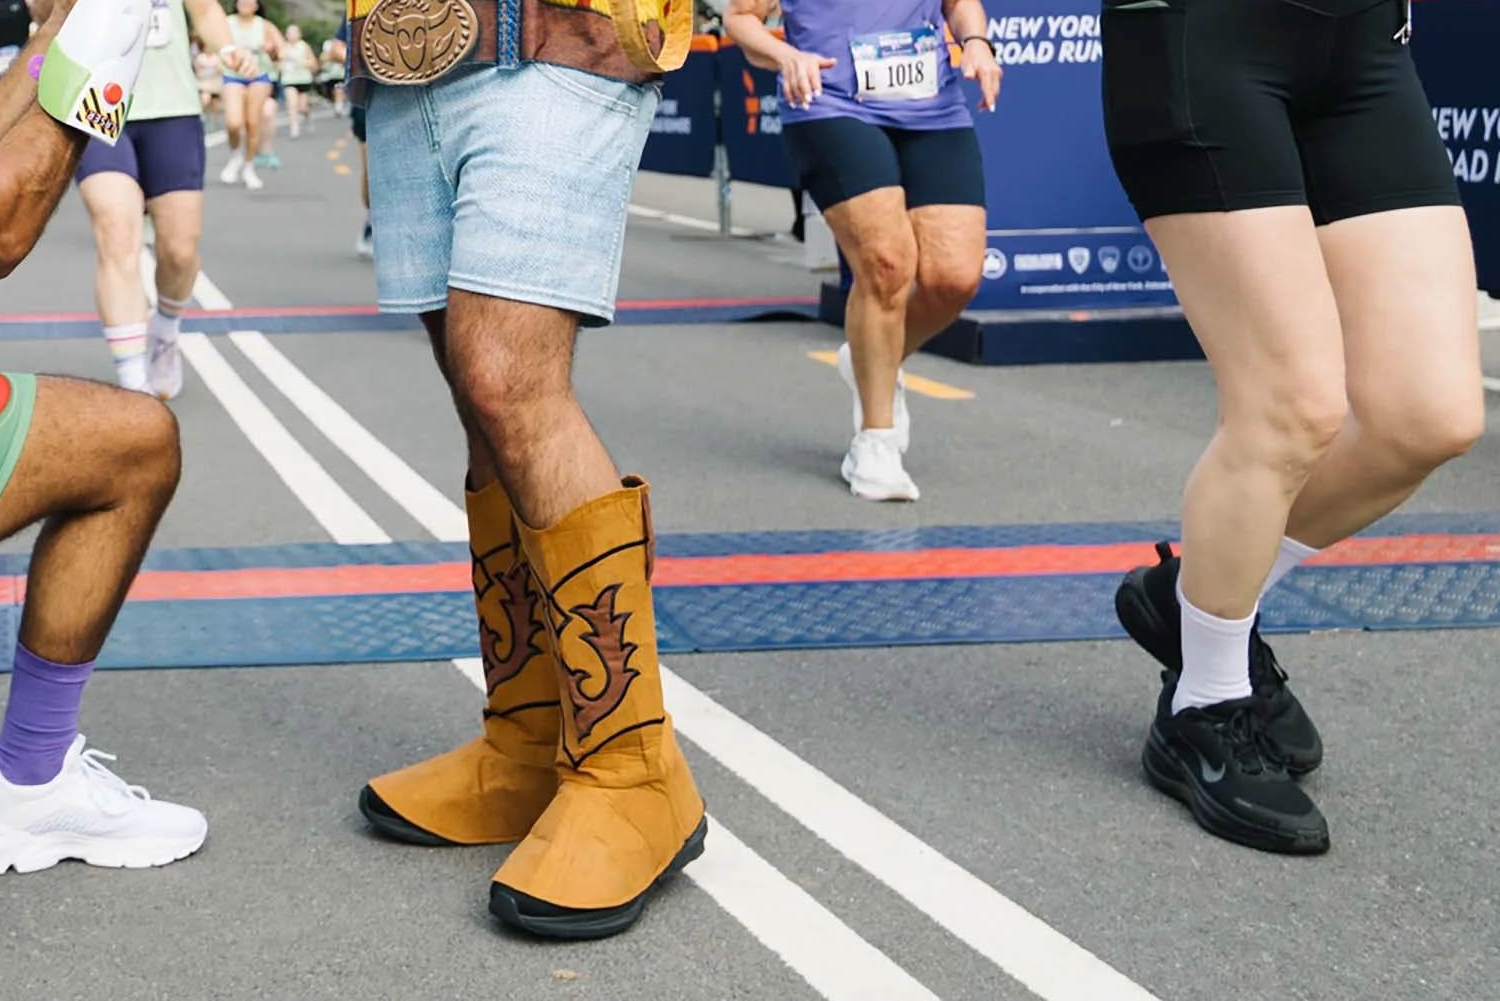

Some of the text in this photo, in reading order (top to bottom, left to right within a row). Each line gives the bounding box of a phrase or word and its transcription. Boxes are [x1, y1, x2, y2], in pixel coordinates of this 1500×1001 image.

[986, 15, 1045, 40] NEW
[865, 60, 925, 91] L 1018
